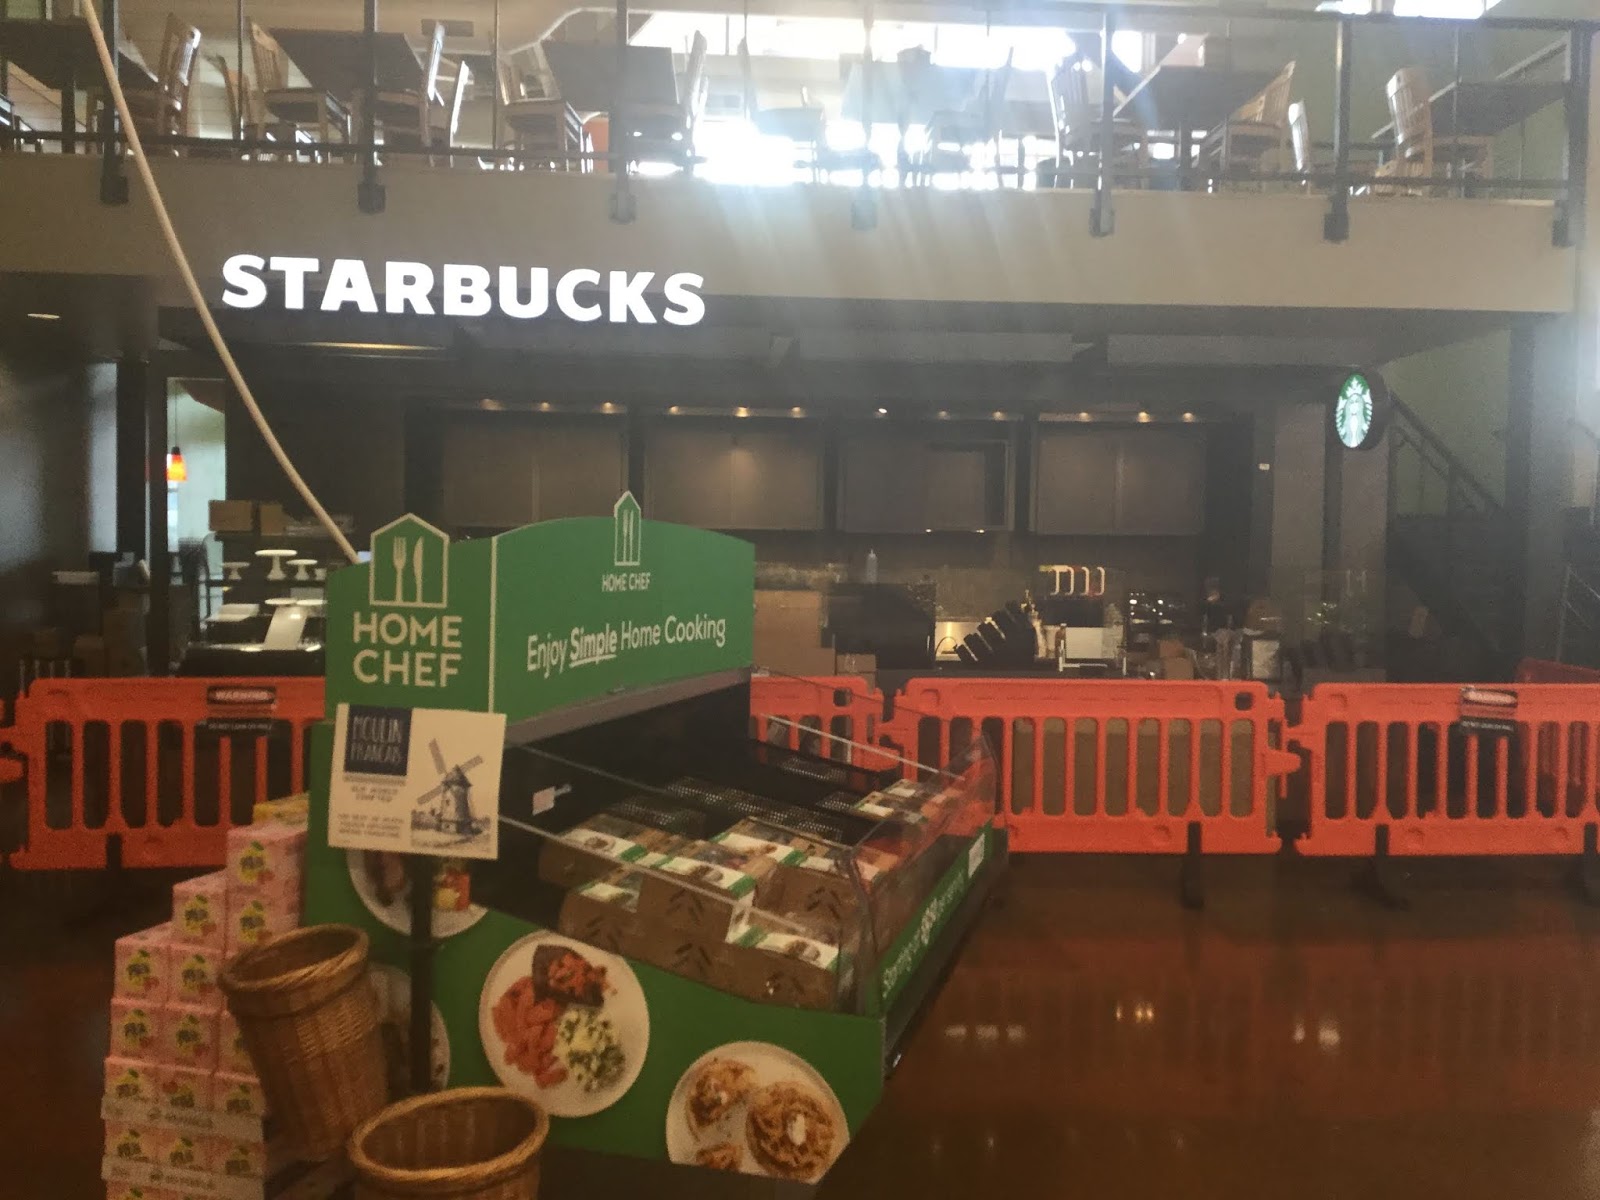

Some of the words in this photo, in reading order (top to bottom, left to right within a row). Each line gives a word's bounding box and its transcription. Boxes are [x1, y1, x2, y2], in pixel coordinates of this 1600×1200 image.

[222, 254, 706, 326] STARBUCKS
[602, 573, 626, 592] HOME
[628, 572, 651, 591] CHEF
[353, 612, 462, 648] HOME
[527, 633, 568, 679] Enjoy
[570, 623, 617, 667] Simple
[620, 621, 661, 650] Home
[664, 613, 726, 648] Cooking
[353, 650, 462, 687] CHEF
